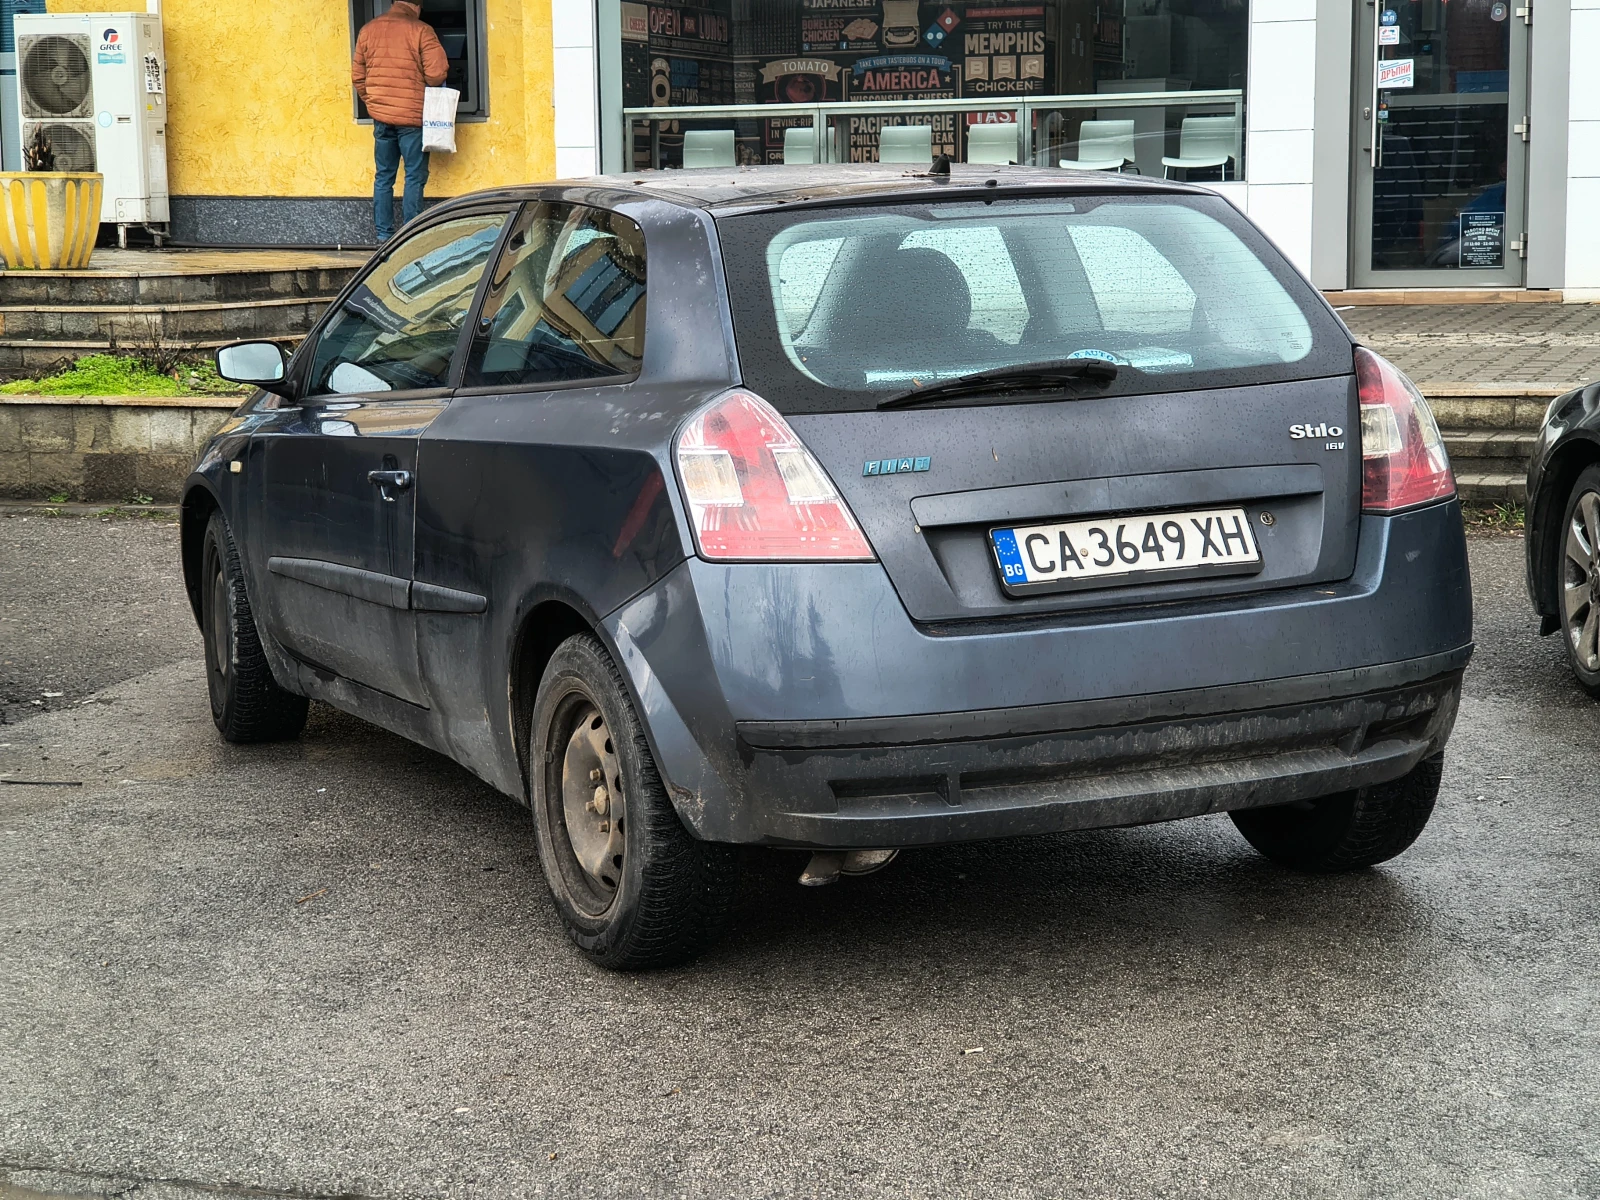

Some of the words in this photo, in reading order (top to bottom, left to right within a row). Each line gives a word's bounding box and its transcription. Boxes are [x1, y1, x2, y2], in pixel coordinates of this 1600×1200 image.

[650, 6, 680, 36] OPEN
[684, 18, 696, 32] FOR
[698, 13, 728, 43] LUNCH
[801, 18, 844, 30] BONELESS
[987, 21, 1003, 30] TRY
[1005, 20, 1022, 29] THE
[802, 30, 839, 42] CHICKEN
[964, 31, 1045, 54] MEMPHIS
[782, 61, 829, 73] TOMATO
[859, 61, 872, 69] TAKE
[888, 56, 917, 65] TASTEBUDS
[931, 58, 945, 66] TOUR
[1381, 63, 1411, 81] ДРЪПНИ
[862, 69, 941, 91] AMERICA
[975, 80, 1034, 92] CHICKEN
[850, 116, 902, 134] PACIFIC
[771, 129, 780, 139] IN
[1084, 350, 1114, 361] AUTO
[1289, 422, 1344, 440] Stilo
[1325, 441, 1345, 451] 16V
[867, 459, 928, 473] FIAT
[1025, 530, 1085, 574] CA
[1088, 520, 1186, 568] 3649
[1190, 515, 1250, 558] XH
[1004, 563, 1024, 577] BG
